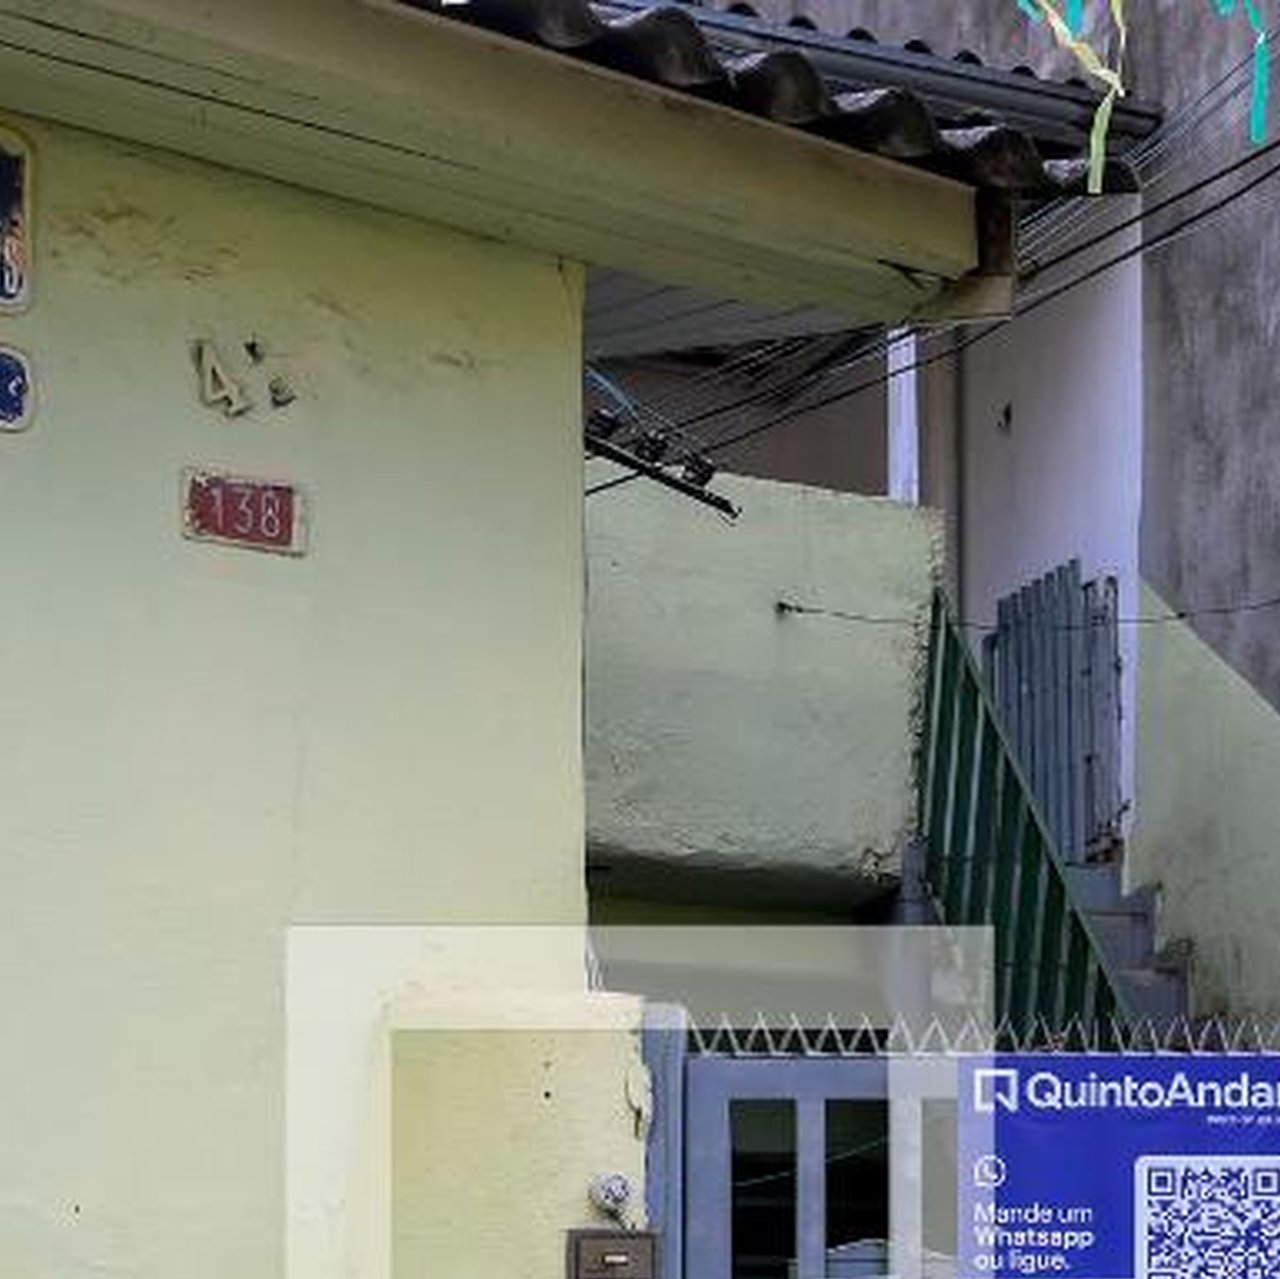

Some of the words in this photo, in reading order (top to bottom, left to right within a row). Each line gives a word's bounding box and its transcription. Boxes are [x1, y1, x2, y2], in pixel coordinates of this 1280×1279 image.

[211, 485, 281, 538] 138
[973, 1201, 1053, 1223] Mande
[1057, 1207, 1093, 1223] um
[973, 1226, 1095, 1250] Whatsapp
[973, 1254, 1003, 1271] ou
[1008, 1249, 1071, 1274] ligue.
